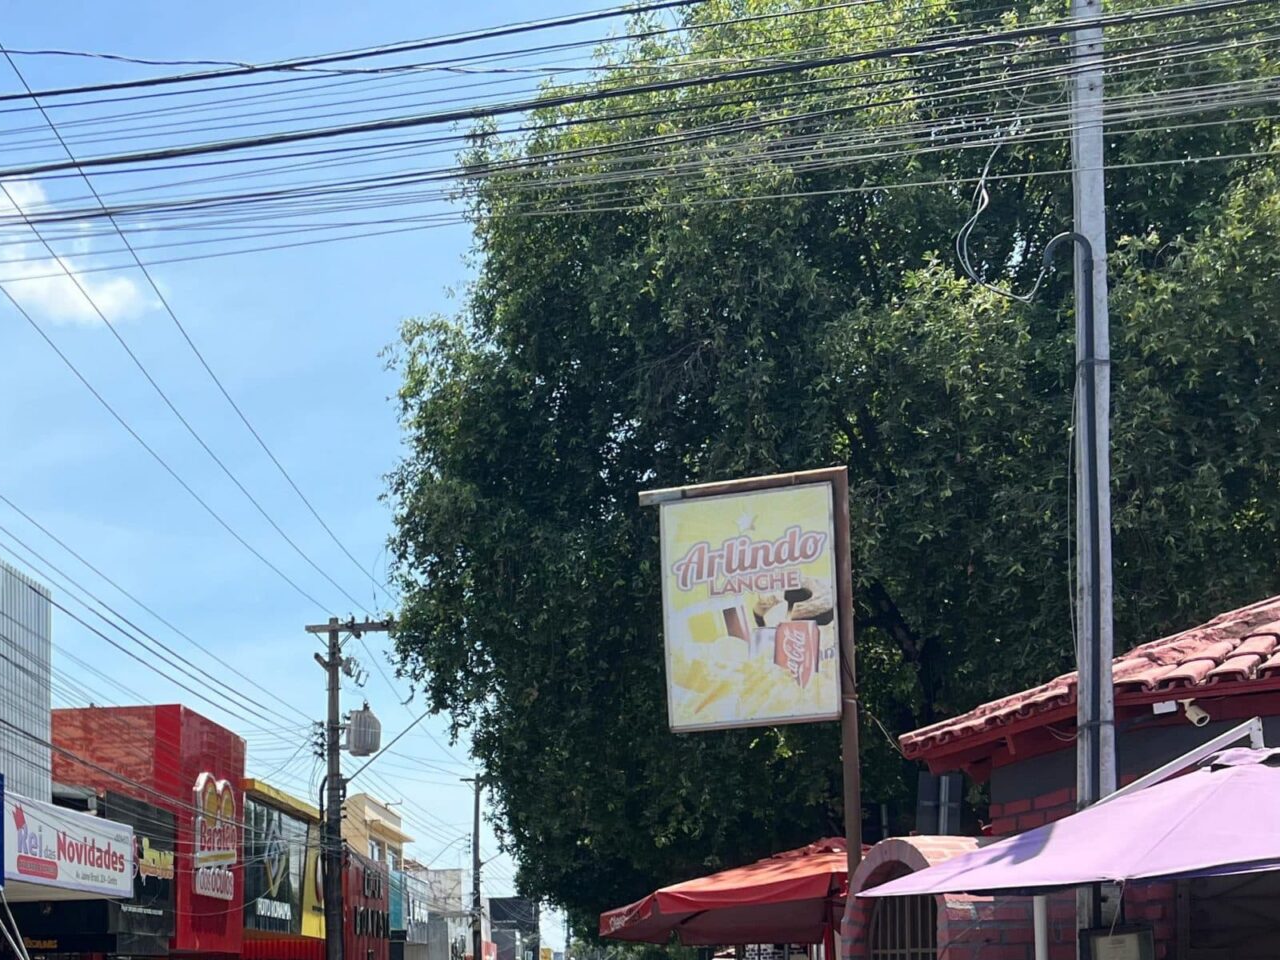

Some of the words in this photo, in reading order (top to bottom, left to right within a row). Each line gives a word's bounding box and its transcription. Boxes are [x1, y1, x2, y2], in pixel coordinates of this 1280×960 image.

[674, 529, 825, 588] Arlindo
[709, 571, 800, 596] LANCHE
[17, 823, 43, 859] Rei
[43, 845, 57, 860] das
[56, 830, 126, 874] Novidades
